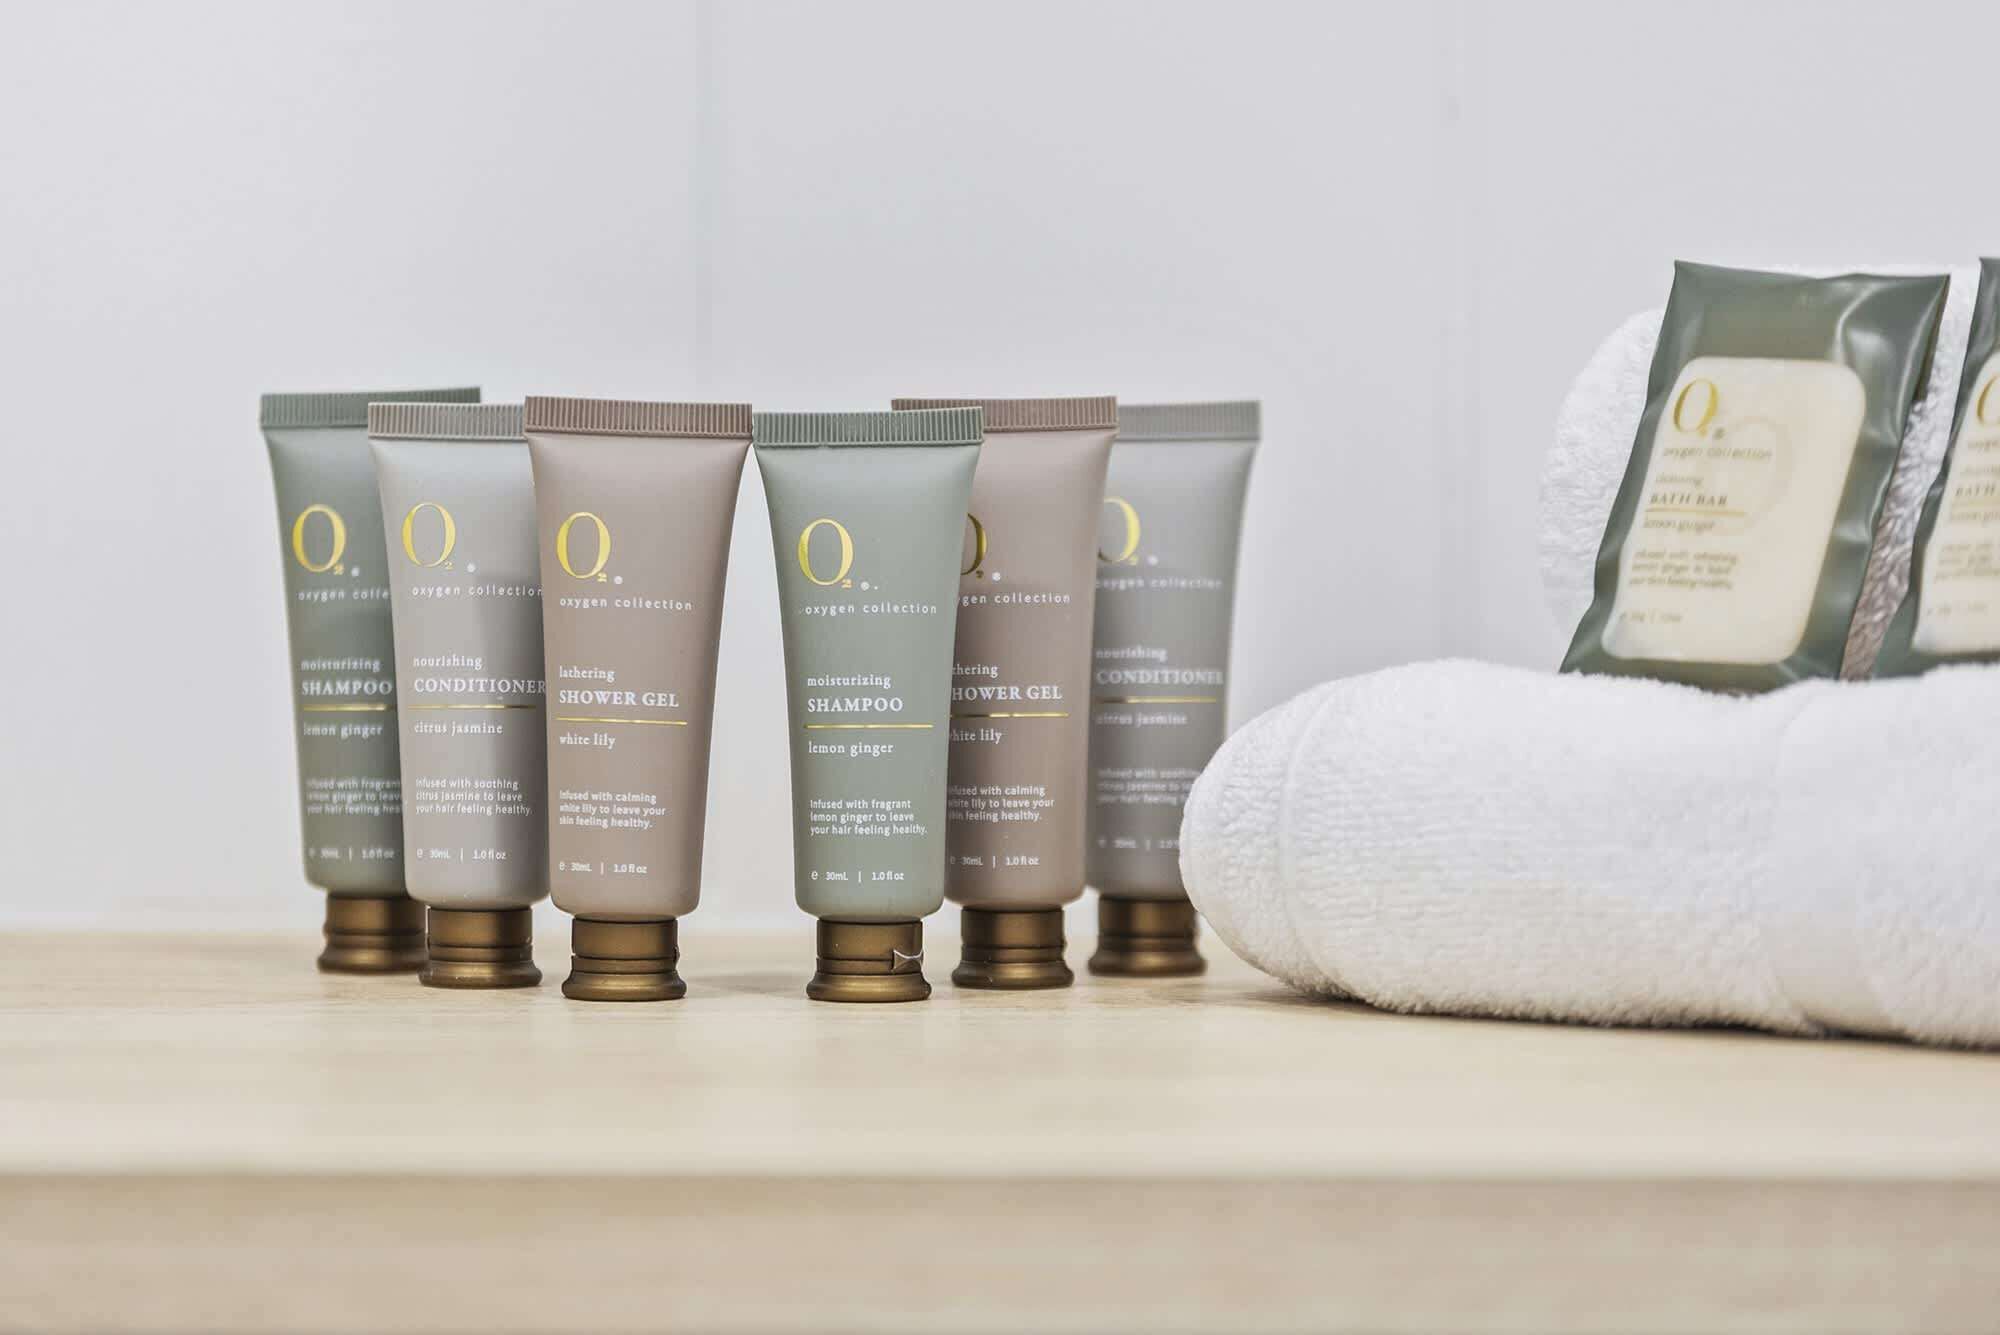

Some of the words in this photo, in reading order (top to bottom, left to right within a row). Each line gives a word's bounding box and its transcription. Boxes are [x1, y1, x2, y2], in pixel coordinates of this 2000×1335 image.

[1650, 492, 1690, 505] BATH
[352, 586, 389, 600] colle
[412, 585, 460, 598] oxygen
[468, 583, 543, 597] collection
[559, 597, 608, 609] oxygen
[615, 597, 692, 611] collection
[958, 594, 987, 607] gen
[994, 592, 1071, 604] collection
[805, 603, 855, 617] oxygen
[863, 602, 937, 614] collection
[1096, 646, 1168, 662] nourishing
[301, 657, 381, 672] moisturizing
[413, 654, 482, 670] nourishing
[559, 665, 615, 682] lathering
[952, 664, 999, 679] thering
[302, 680, 392, 695] SHAMPOO
[414, 677, 546, 694] CONDITIONER
[807, 674, 891, 689] moisturizing
[559, 690, 637, 705] SHOWER
[642, 691, 679, 707] GEL
[952, 686, 1022, 701] HOWER
[1026, 685, 1063, 700] GEL
[807, 697, 903, 713] SHAMPOO
[303, 721, 336, 736] lemon
[341, 724, 382, 740] ginger
[414, 721, 447, 734] citrus
[451, 721, 503, 737] jasmine
[951, 729, 976, 741] hite
[980, 728, 1002, 744] lily
[559, 732, 590, 745] white
[593, 733, 616, 749] lily
[808, 740, 845, 754] lemon
[850, 741, 894, 757] ginger
[361, 778, 401, 792] fragran
[448, 777, 471, 788] with
[474, 778, 519, 791] soothing
[980, 785, 1002, 795] with
[1005, 785, 1046, 797] calming
[379, 790, 401, 801] leav
[441, 791, 480, 803] jasmine
[483, 791, 494, 801] to
[497, 791, 523, 802] leave
[591, 791, 613, 801] with
[615, 792, 657, 805] calming
[435, 803, 454, 814] hair
[457, 803, 493, 816] feeling
[600, 805, 610, 814] to
[612, 805, 640, 815] leave
[643, 807, 666, 817] your
[846, 799, 868, 809] with
[871, 799, 911, 811] fragrant
[989, 799, 1000, 808] to
[1003, 798, 1030, 808] leave
[1033, 799, 1055, 810] your
[576, 815, 609, 829] feeling
[611, 817, 653, 830] healthy.
[810, 811, 837, 822] lemon
[840, 812, 873, 824] ginger
[875, 812, 887, 822] to
[889, 811, 914, 822] leave
[966, 810, 999, 823] feeling
[1001, 810, 1042, 822] healthy.
[810, 825, 829, 836] your
[832, 824, 851, 835] hair
[854, 824, 890, 837] feeling
[892, 823, 928, 836] healthy.
